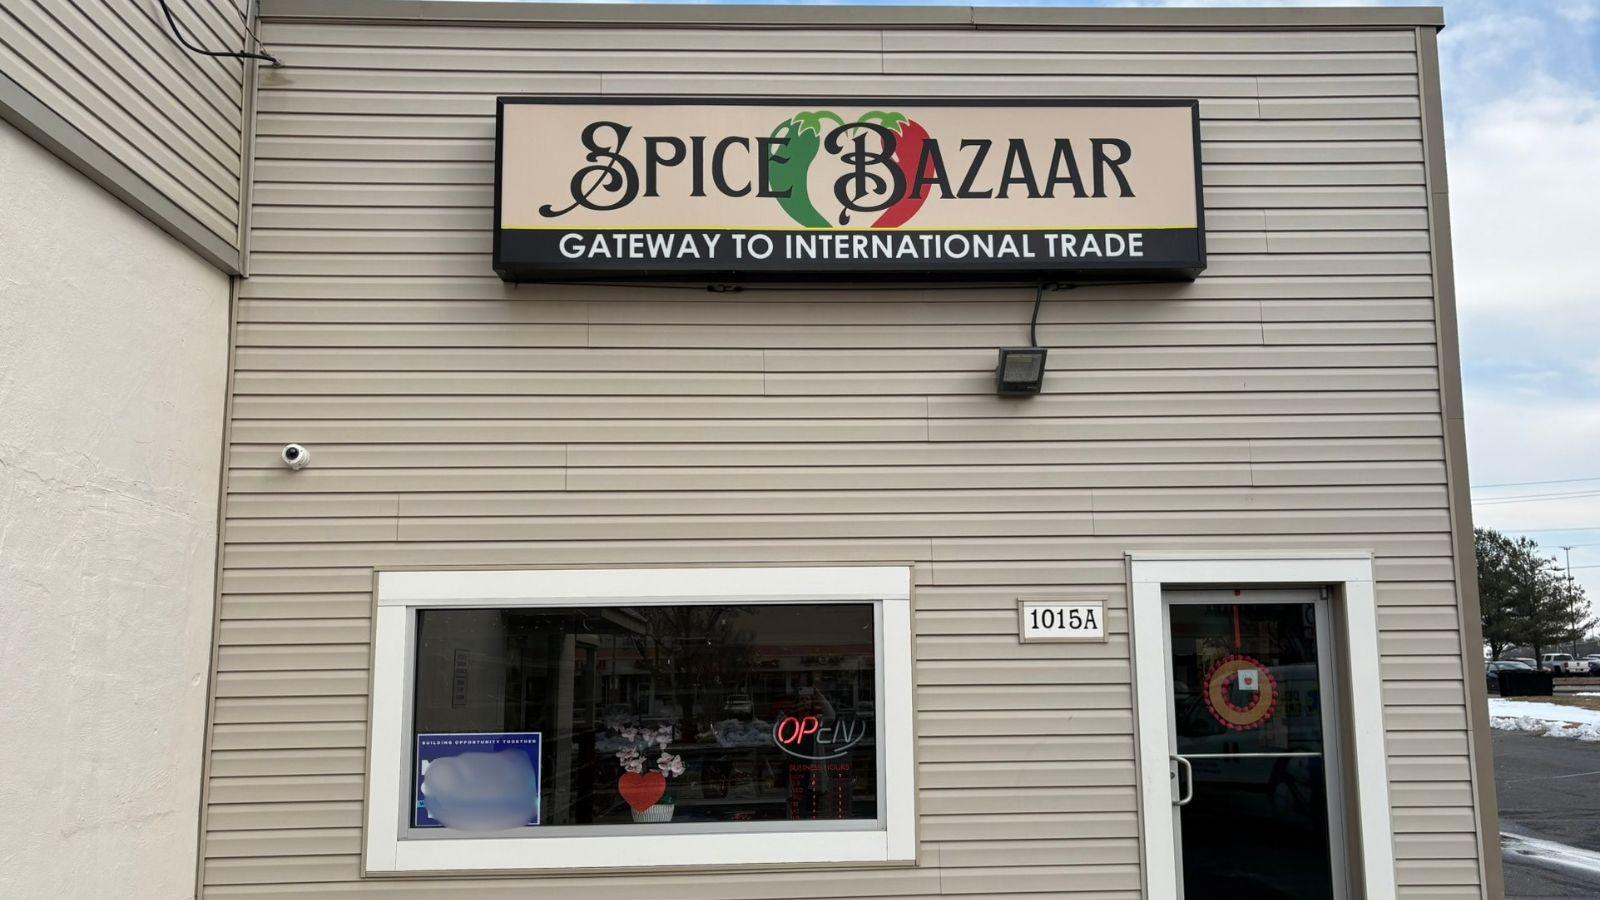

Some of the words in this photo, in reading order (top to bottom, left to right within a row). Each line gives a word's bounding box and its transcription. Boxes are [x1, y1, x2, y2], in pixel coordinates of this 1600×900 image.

[538, 121, 794, 218] SPICE
[824, 121, 1136, 226] BAZAAR
[559, 233, 721, 260] GATEWAY
[732, 233, 774, 260] TO
[786, 233, 1035, 260] INTERNATIONAL
[1044, 233, 1144, 257] TRADE
[1030, 608, 1098, 630] 1015A
[778, 716, 855, 744] OPEN
